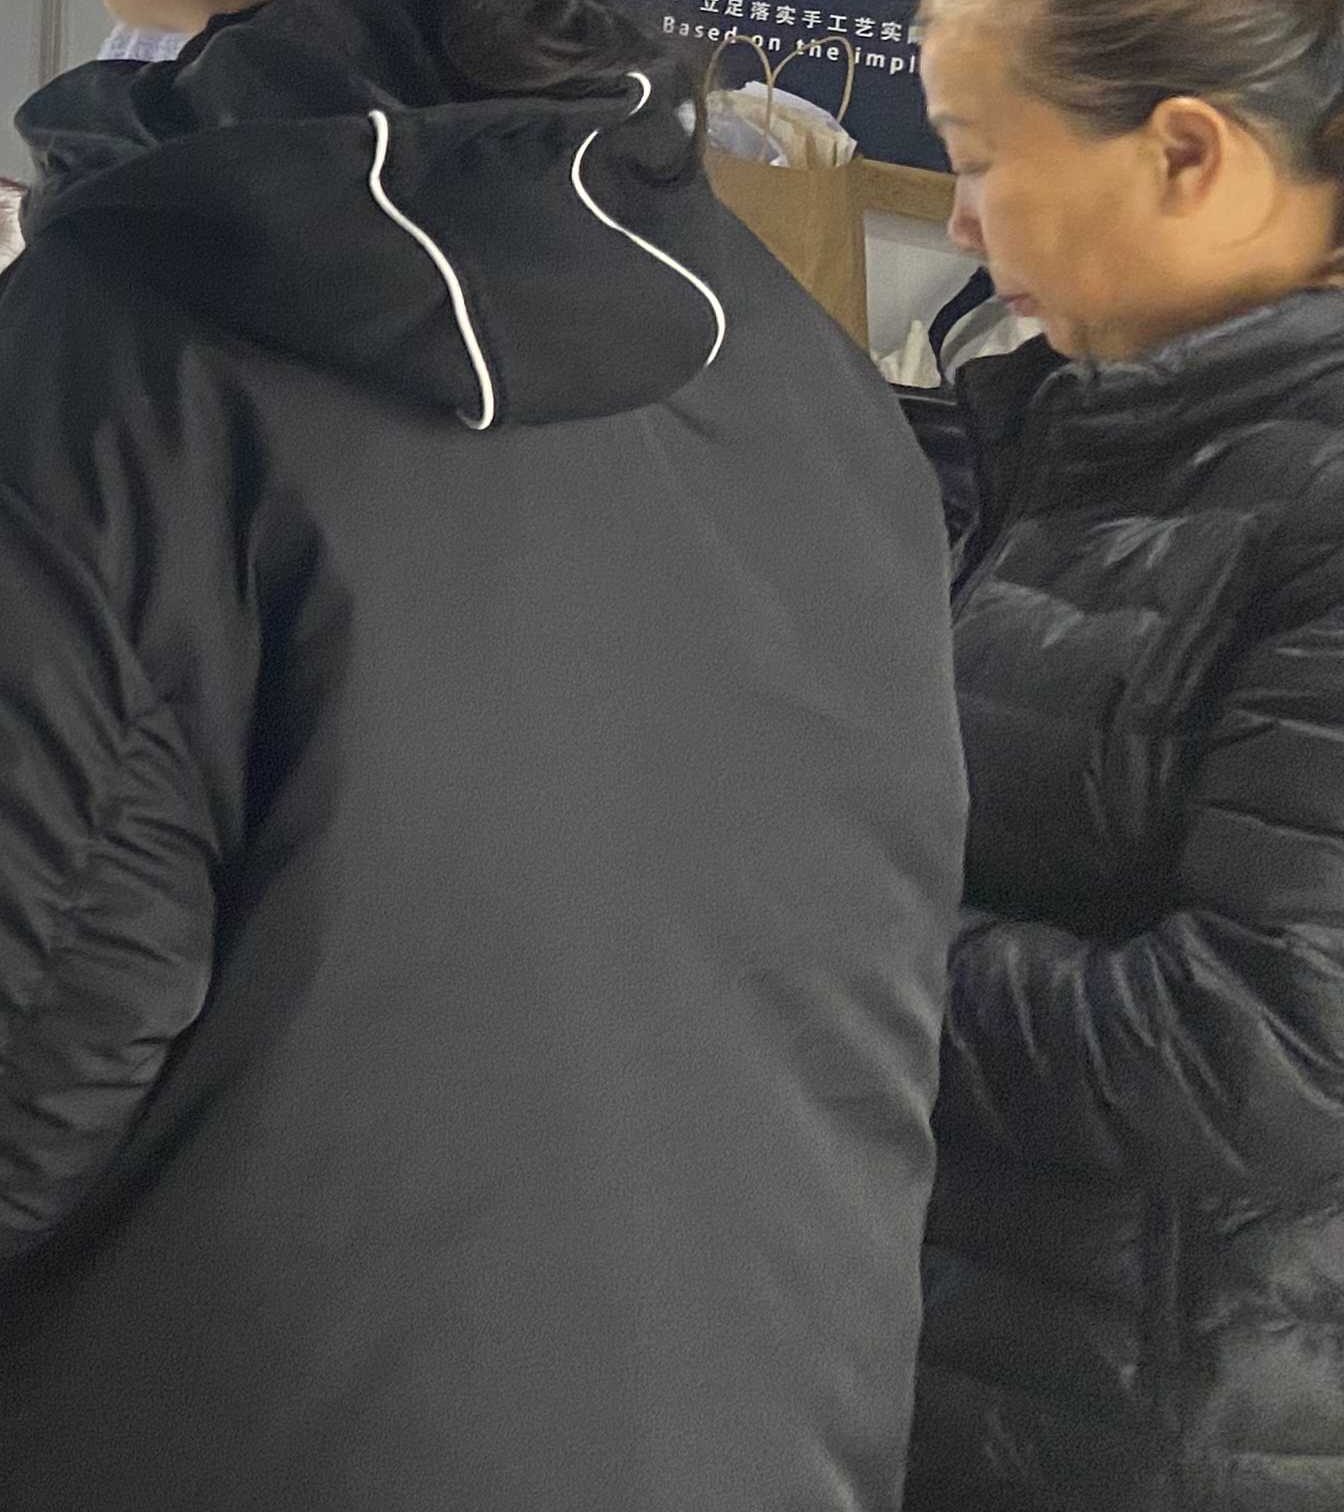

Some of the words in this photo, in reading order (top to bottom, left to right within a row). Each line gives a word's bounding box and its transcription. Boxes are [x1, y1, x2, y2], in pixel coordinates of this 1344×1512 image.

[662, 15, 738, 44] Based
[752, 34, 781, 52] on
[796, 39, 839, 61] the
[854, 46, 917, 75] impl
